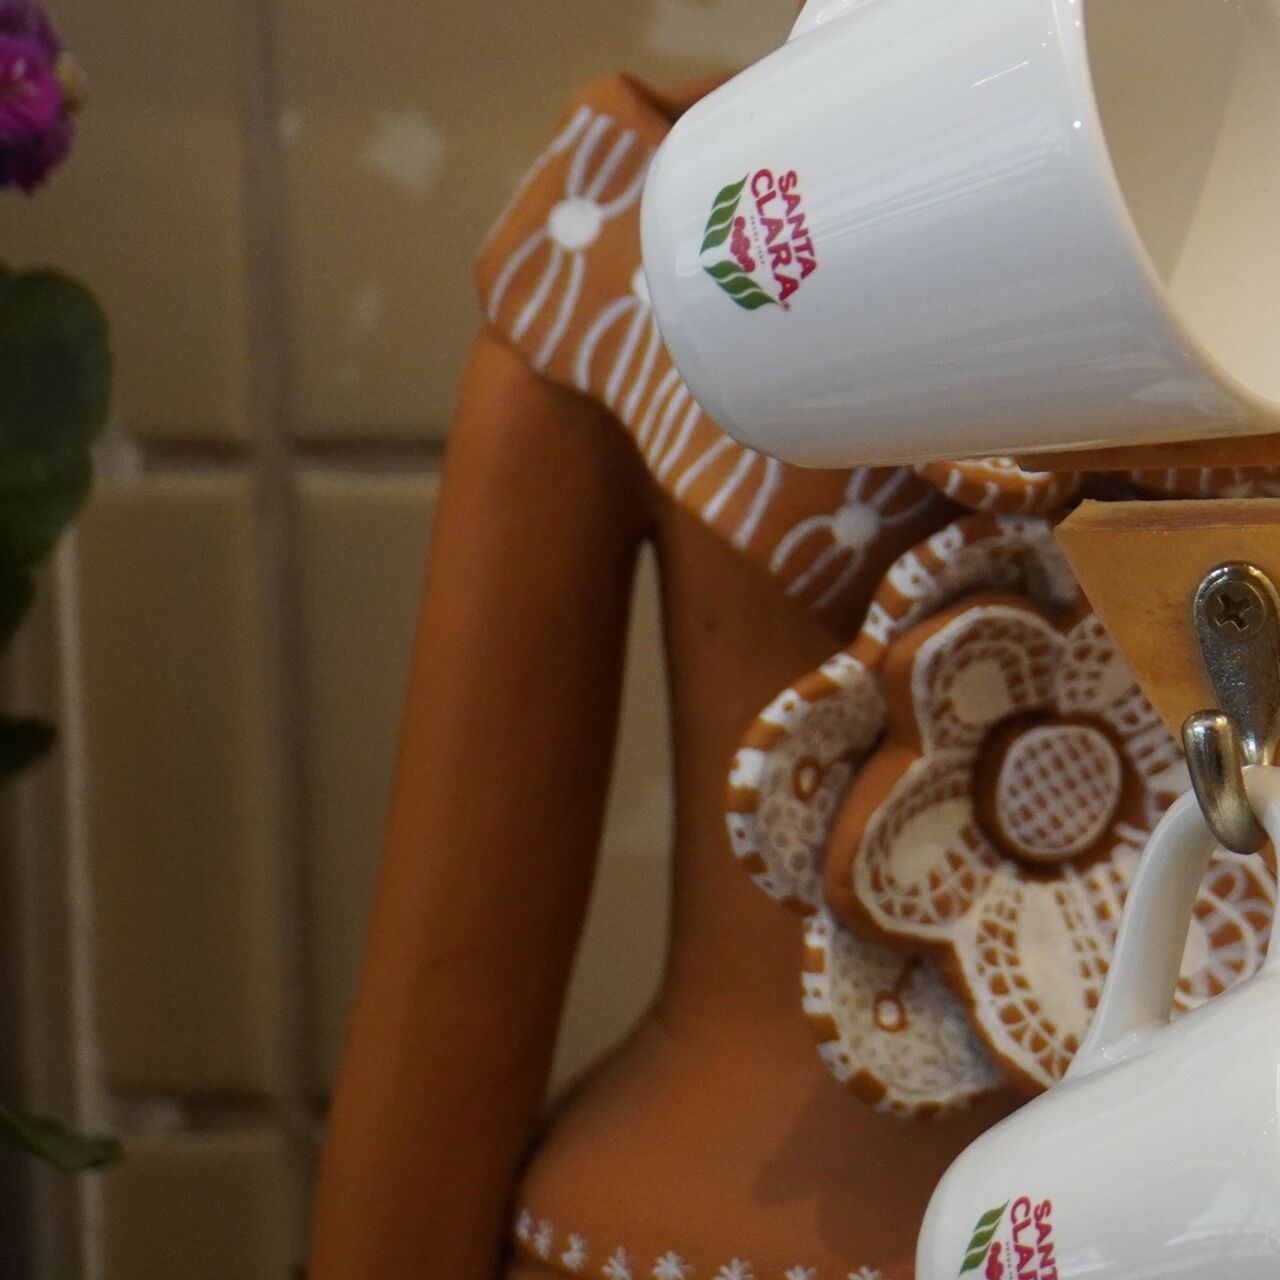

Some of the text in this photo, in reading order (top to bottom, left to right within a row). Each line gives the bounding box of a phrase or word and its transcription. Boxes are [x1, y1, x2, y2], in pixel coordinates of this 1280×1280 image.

[751, 168, 799, 302] CLARA
[778, 170, 817, 279] SANTA
[1011, 1196, 1038, 1280] CLA
[1034, 1199, 1058, 1280] SANT
